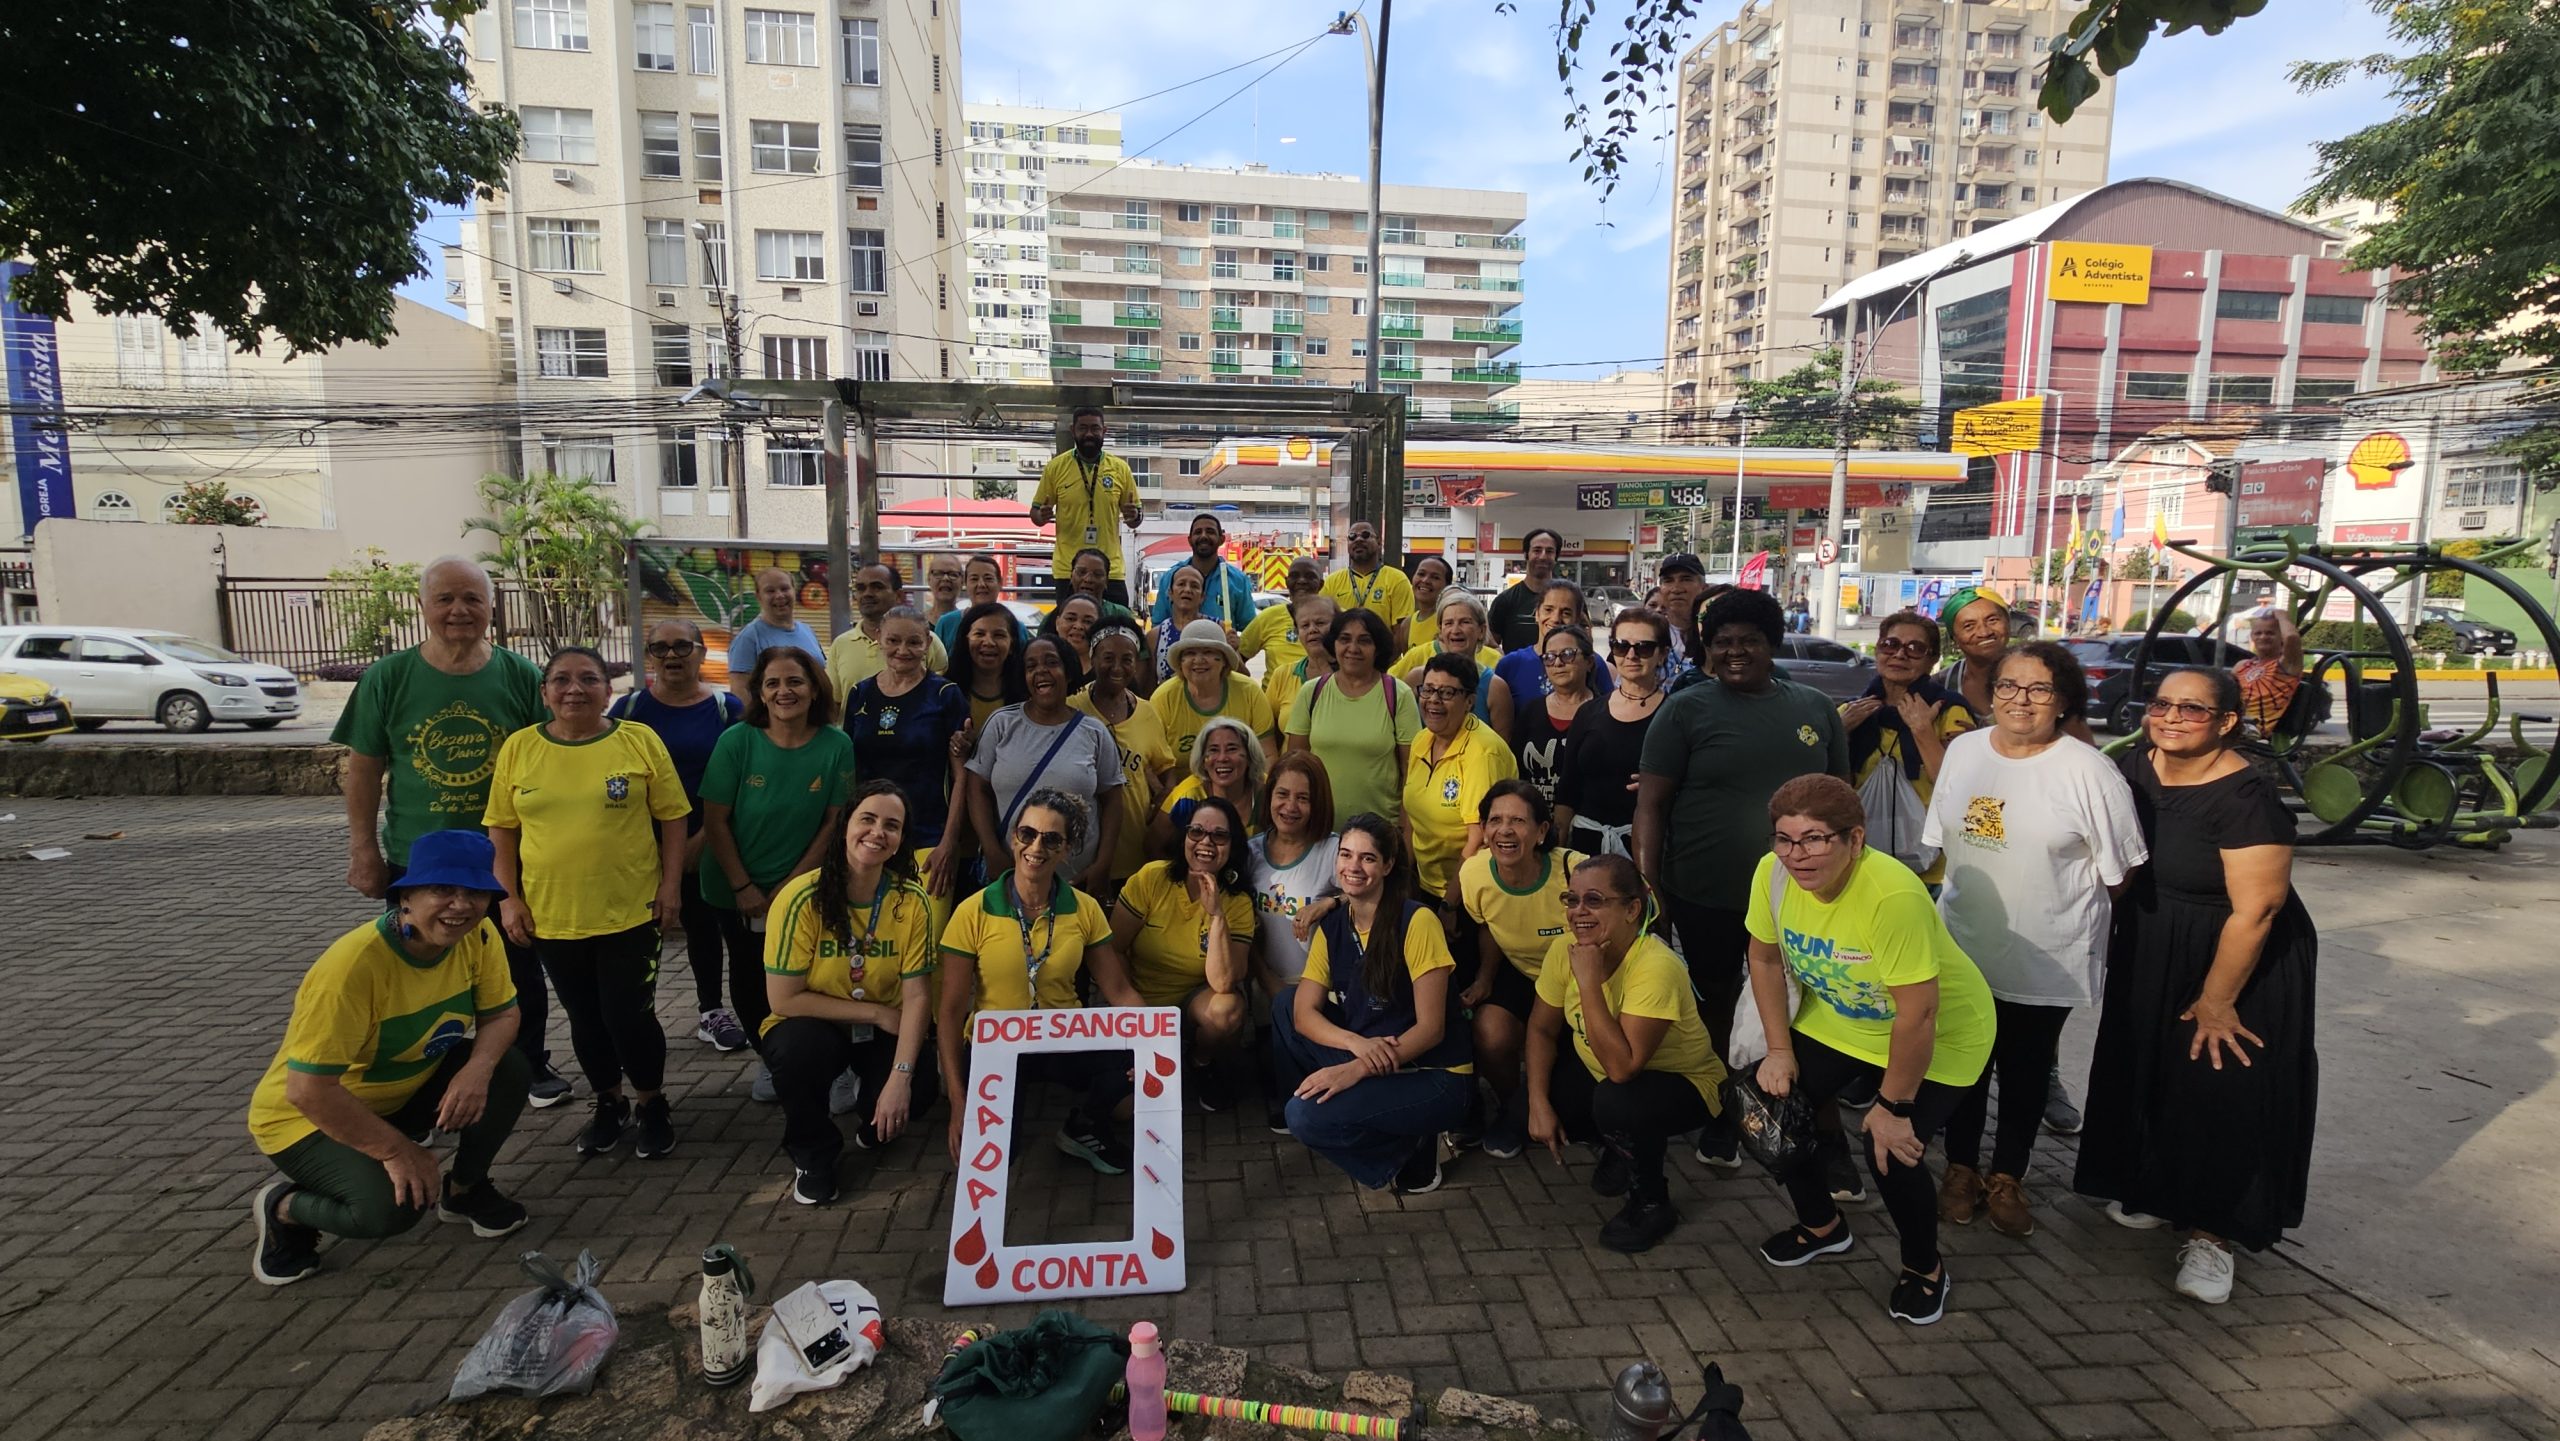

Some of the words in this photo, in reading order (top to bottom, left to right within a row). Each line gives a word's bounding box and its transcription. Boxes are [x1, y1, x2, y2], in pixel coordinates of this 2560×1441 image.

[2085, 258, 2124, 271] Colégio
[2084, 270, 2144, 281] Adventista
[31, 333, 63, 475] Medista
[2278, 465, 2303, 473] Cidade
[41, 478, 51, 517] IGREJA
[1563, 539, 1580, 549] lect
[428, 730, 487, 750] Bezerra
[447, 746, 486, 762] Dance
[1540, 928, 1564, 936] SPOR
[1783, 927, 1835, 960] RUN
[976, 1015, 1043, 1043] DOE
[1048, 1012, 1177, 1038] SANGUE
[966, 1073, 1005, 1212] CADA
[1011, 1253, 1148, 1293] CONTA
